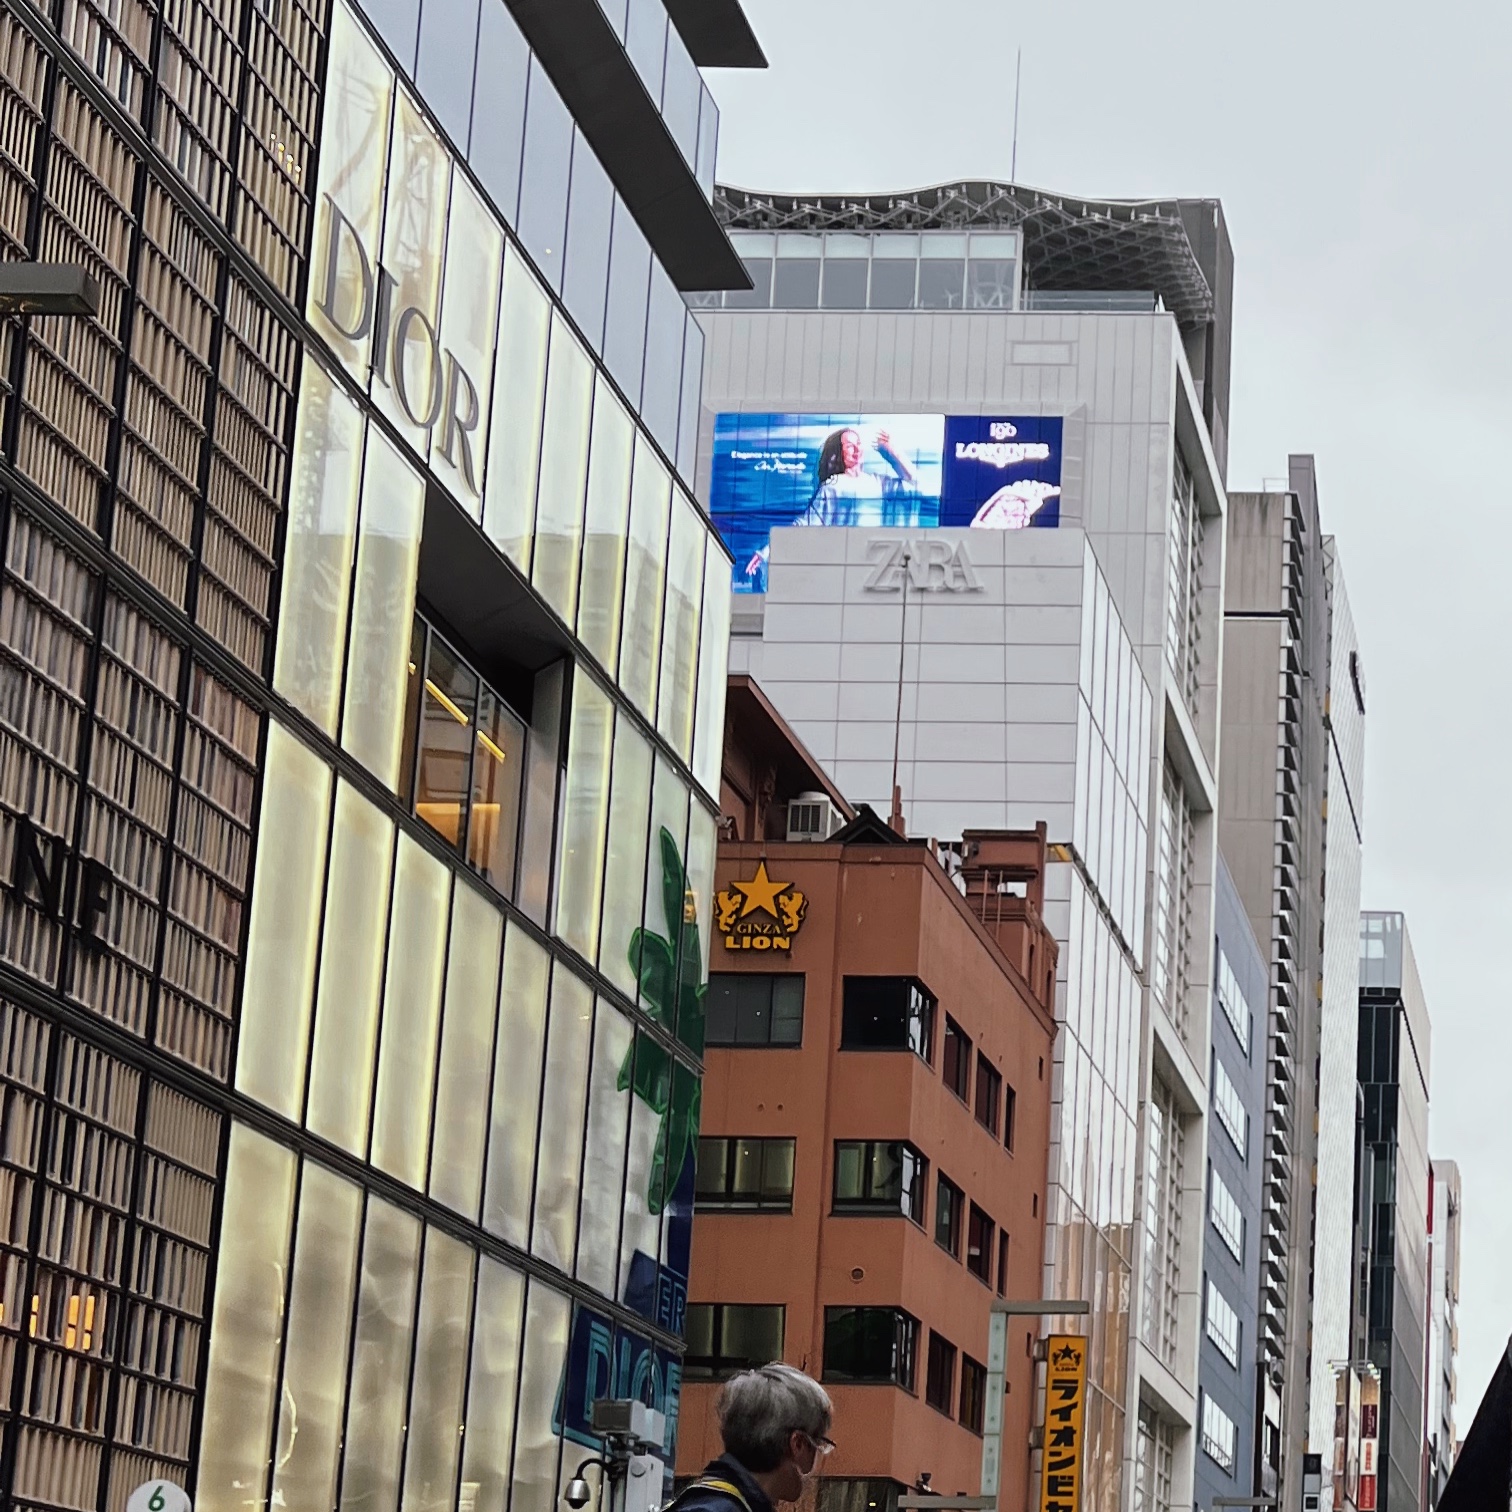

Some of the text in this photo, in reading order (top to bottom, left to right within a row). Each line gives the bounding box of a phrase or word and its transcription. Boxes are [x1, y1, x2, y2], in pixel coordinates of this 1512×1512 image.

[314, 192, 480, 498] DIOR
[955, 442, 1050, 459] LONGINES
[863, 540, 984, 593] ZARA
[736, 923, 781, 934] GINZA
[725, 935, 790, 949] LION
[148, 1485, 165, 1512] 6
